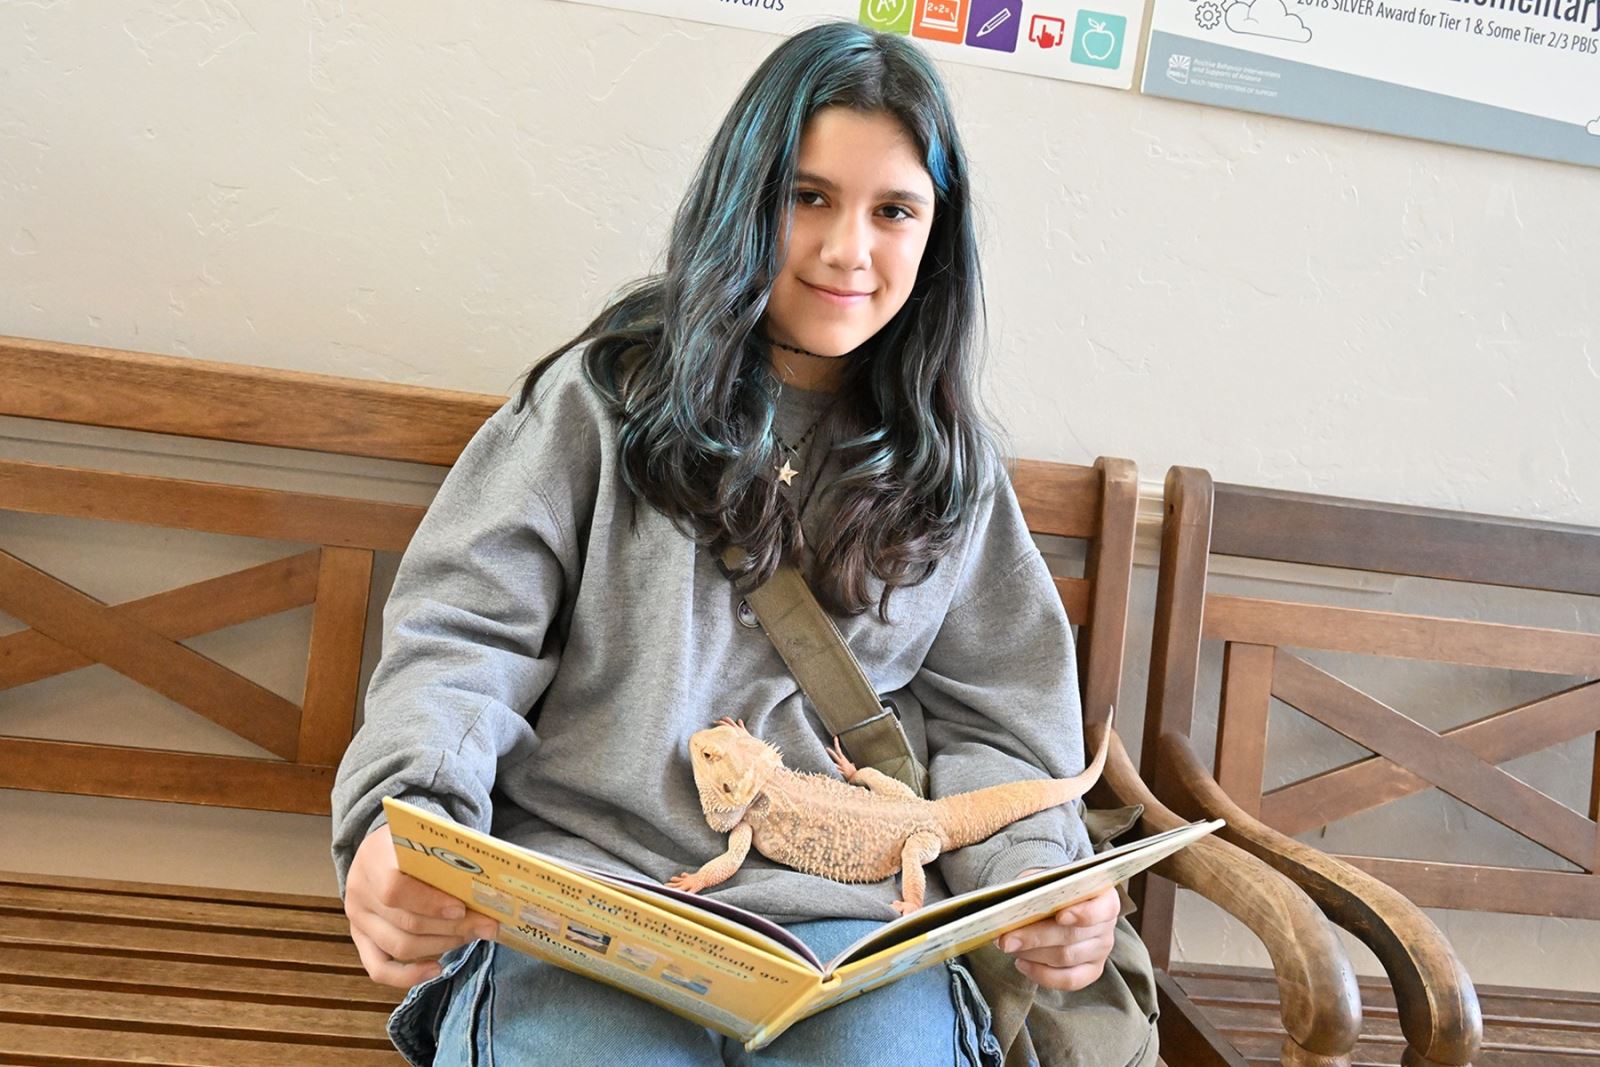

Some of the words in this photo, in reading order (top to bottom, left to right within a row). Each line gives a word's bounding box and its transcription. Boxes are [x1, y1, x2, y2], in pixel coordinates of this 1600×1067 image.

[720, 0, 784, 11] ards
[1331, 0, 1373, 16] SILVER
[1376, 2, 1416, 23] Award
[1418, 9, 1436, 27] for
[1439, 12, 1461, 31] Tier
[1465, 17, 1471, 32] 1
[1474, 18, 1484, 35] &
[1486, 21, 1521, 41] Some
[1523, 26, 1547, 46] Tier
[1547, 32, 1569, 49] 2/3
[1570, 35, 1599, 54] PBIS
[416, 821, 449, 840] The
[455, 837, 511, 866] Pigeon
[535, 873, 583, 894] about
[560, 887, 580, 901] Do
[624, 914, 669, 938] think
[675, 934, 695, 948] he
[700, 945, 755, 973] should
